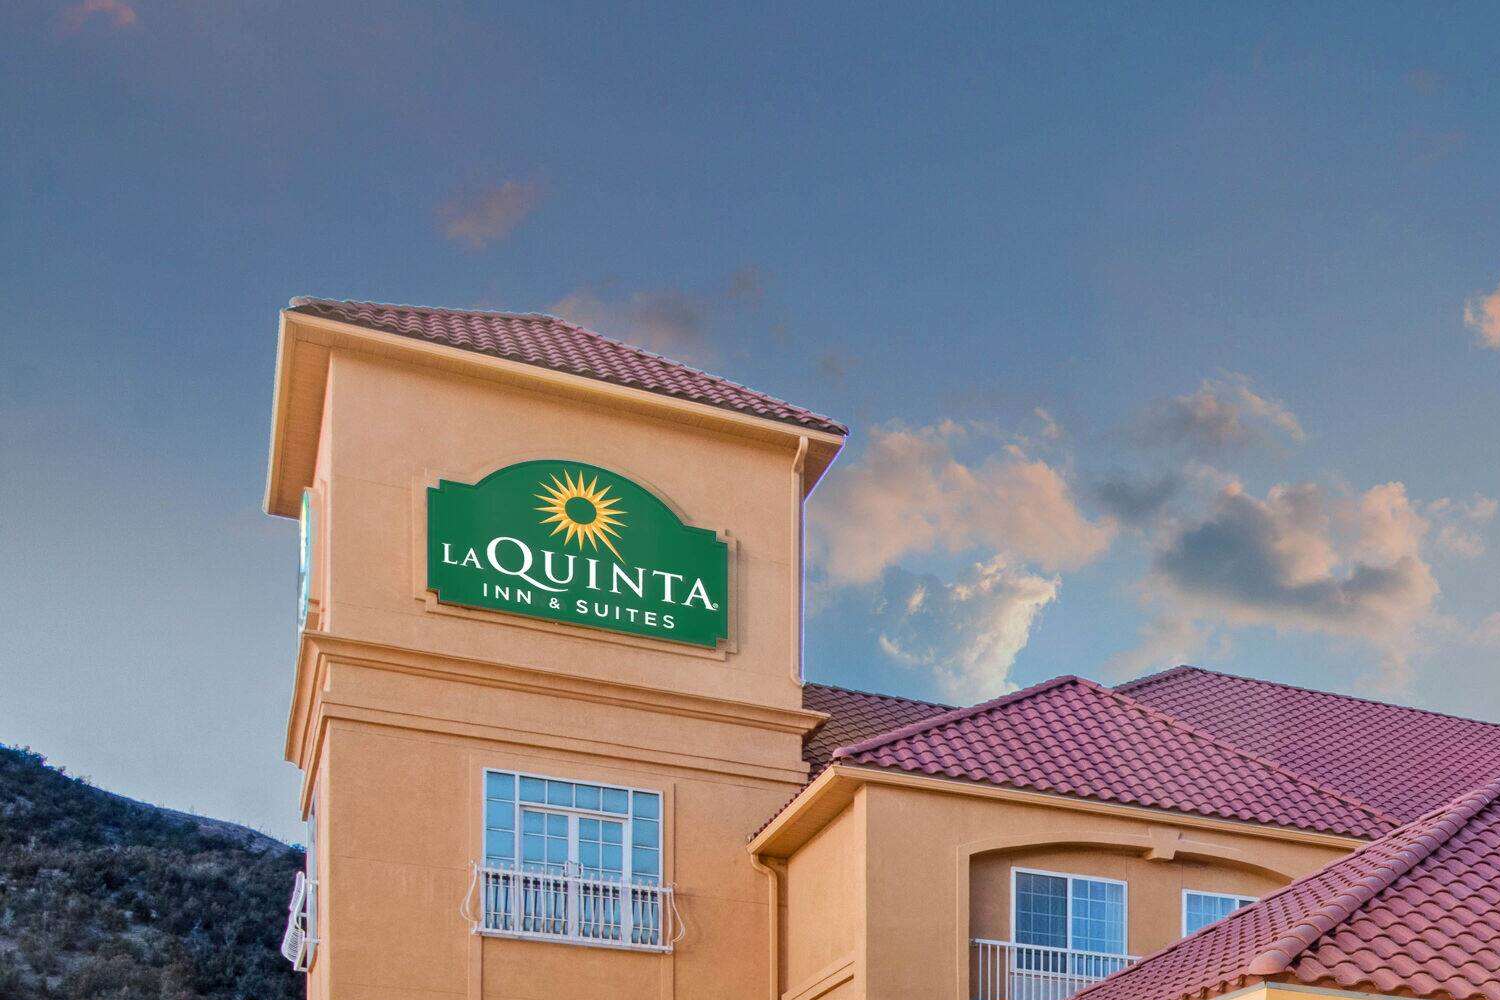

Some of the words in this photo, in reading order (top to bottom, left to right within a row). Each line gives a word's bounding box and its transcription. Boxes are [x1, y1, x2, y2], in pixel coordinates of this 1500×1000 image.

[441, 542, 483, 569] LA
[486, 536, 717, 611] QUINTA
[482, 582, 532, 605] INN
[549, 597, 561, 610] &
[576, 598, 676, 629] SUITES
